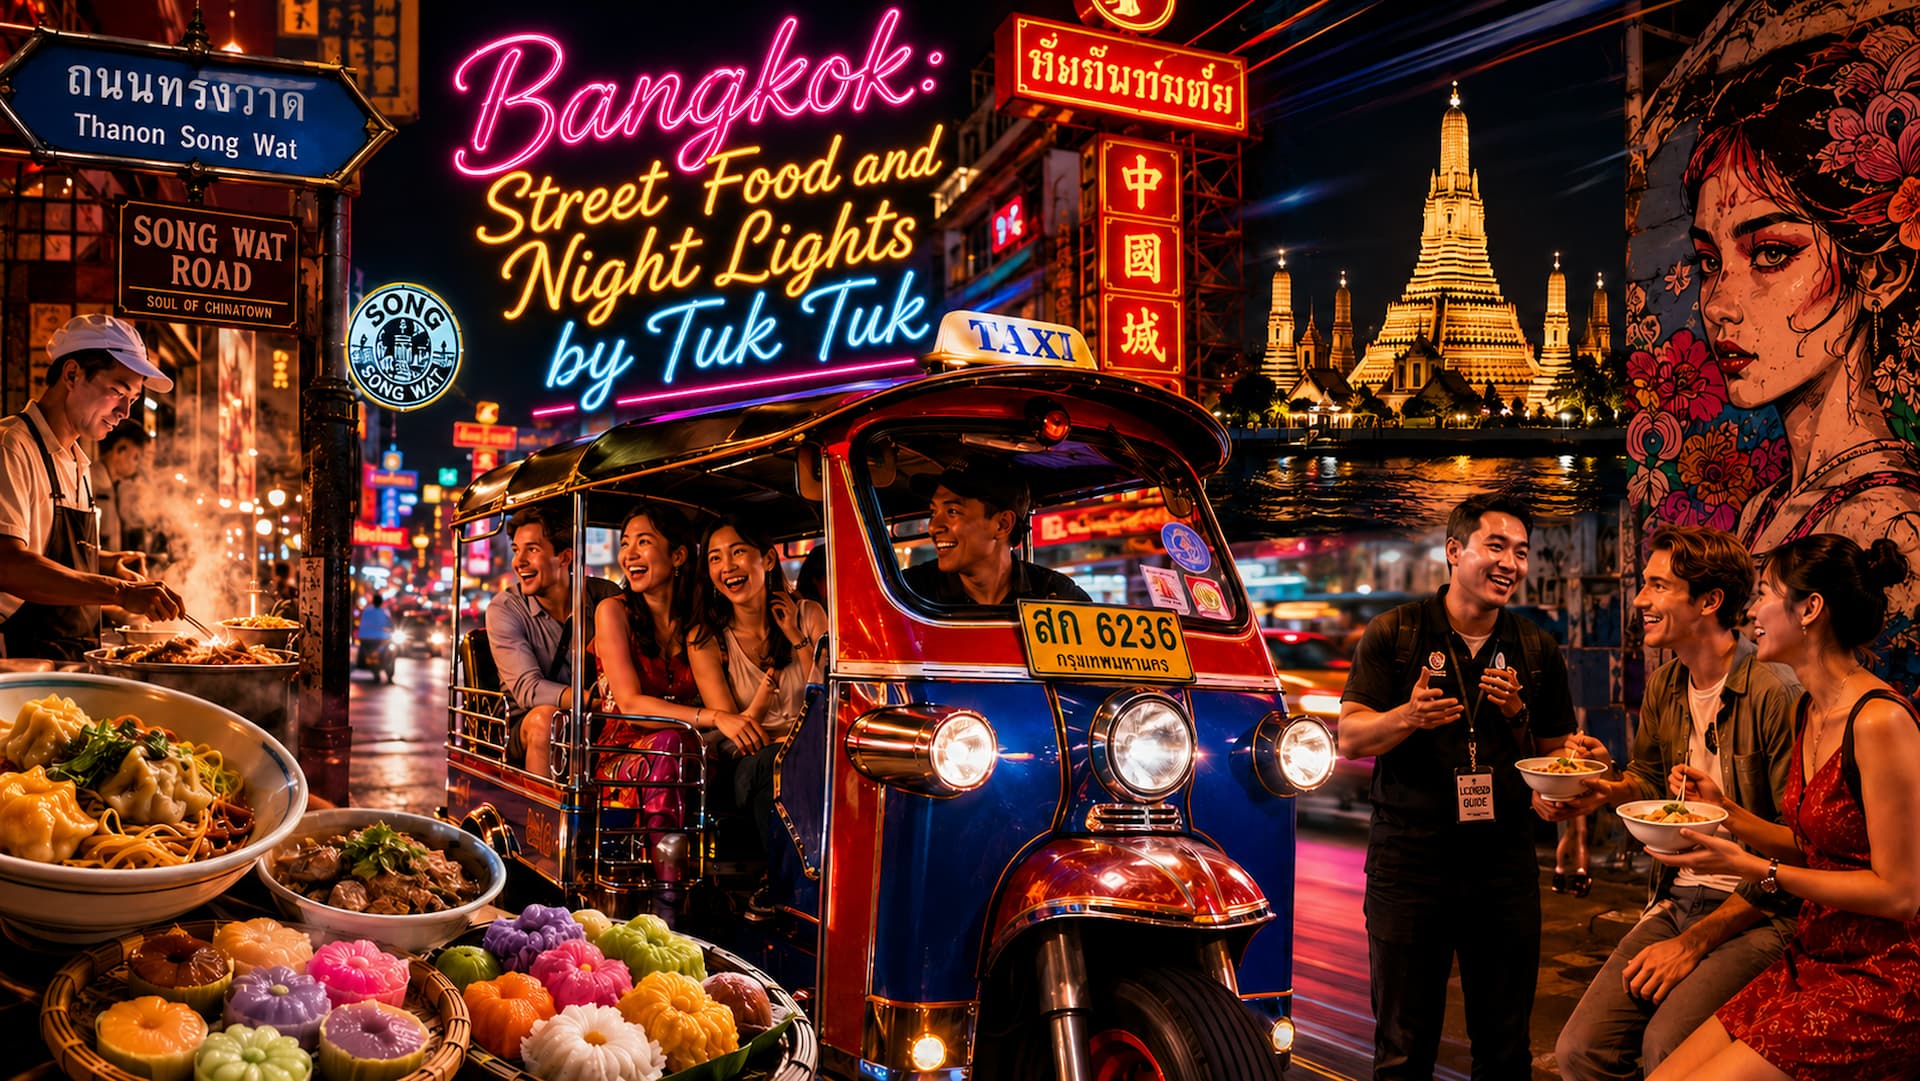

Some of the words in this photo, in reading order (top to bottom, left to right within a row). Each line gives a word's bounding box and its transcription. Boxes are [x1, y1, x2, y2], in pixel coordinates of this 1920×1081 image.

[68, 64, 304, 121] ถนนทรงวาด
[74, 112, 165, 145] Thanon
[180, 125, 239, 158] Song
[253, 132, 298, 160] Wat
[134, 215, 218, 254] SONG
[232, 226, 287, 262] WAT
[171, 254, 252, 292] ROAD
[1121, 154, 1166, 363] 中國城
[146, 295, 178, 310] SOUL
[184, 299, 199, 312] OF
[205, 301, 272, 319] CHINATOWN
[365, 293, 446, 331] SONG
[968, 319, 1076, 362] TAXI
[361, 364, 405, 401] SONG
[410, 367, 444, 399] WAT
[1096, 612, 1177, 650] 6236
[1463, 797, 1488, 808] GUIDE
